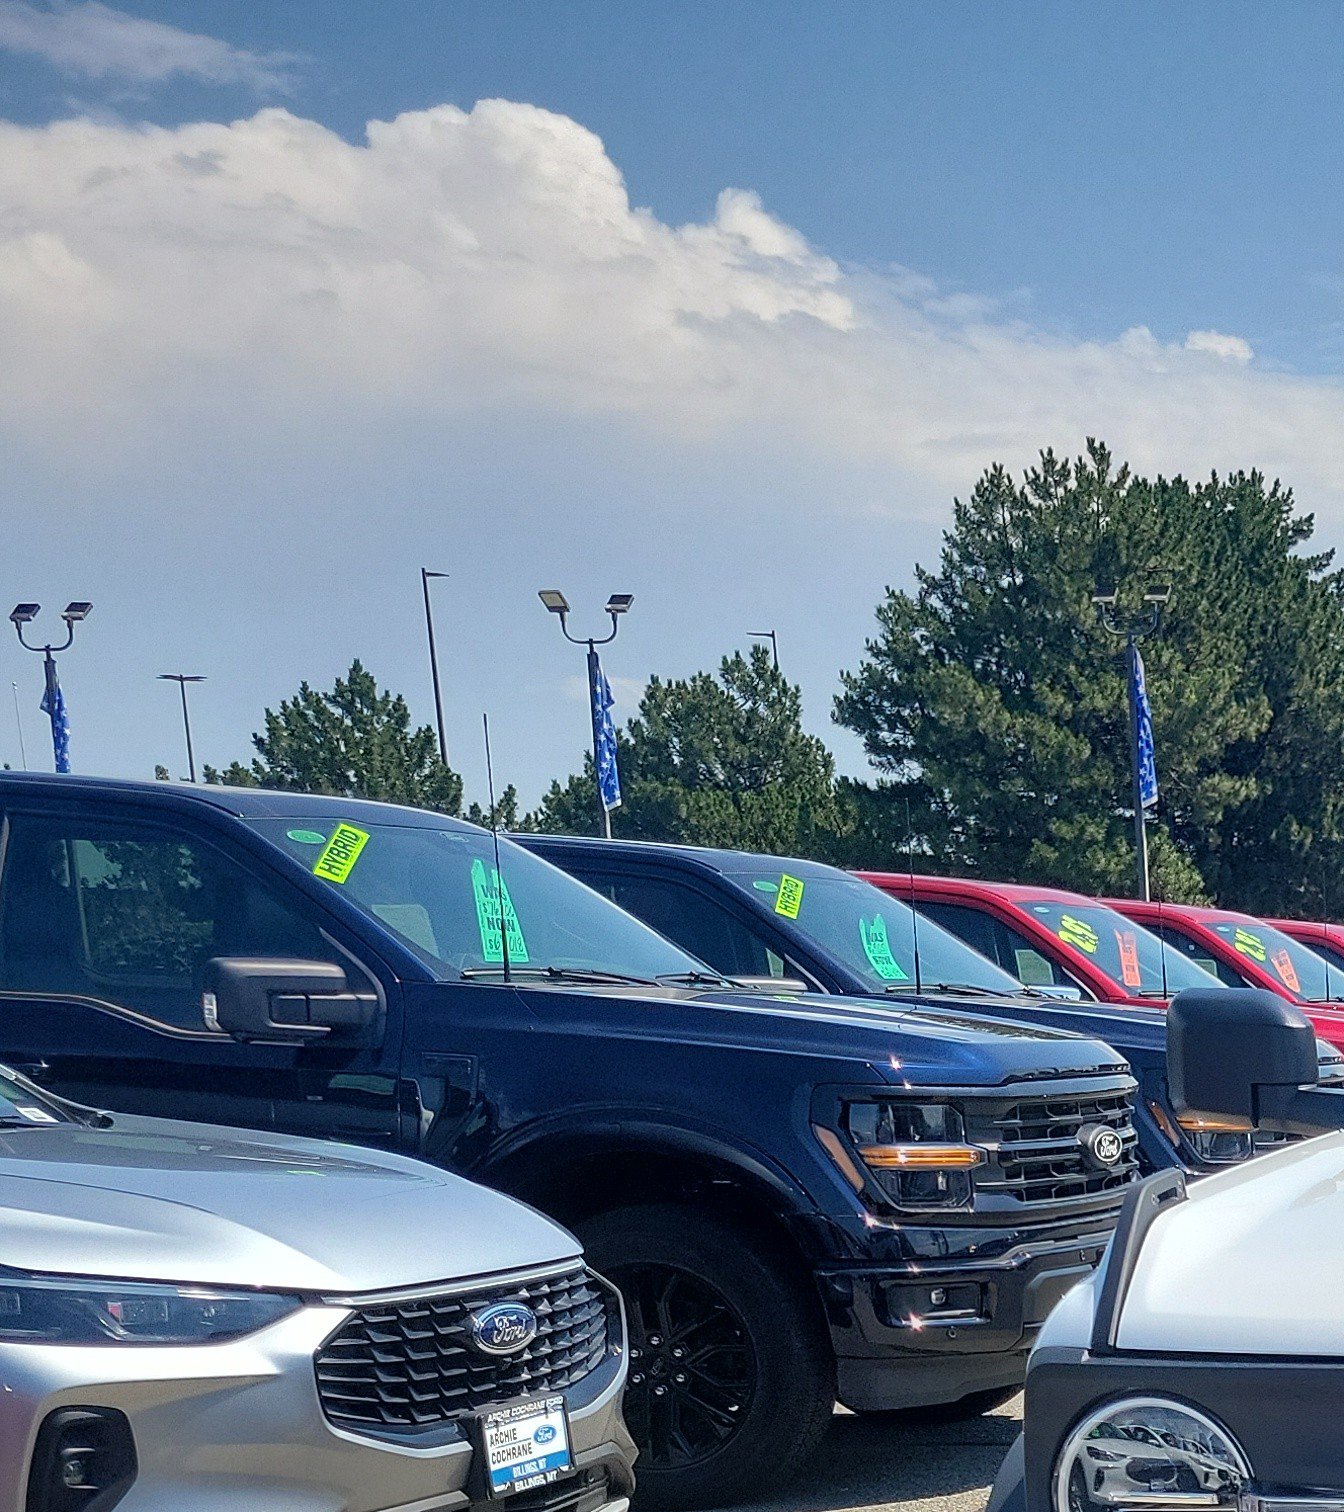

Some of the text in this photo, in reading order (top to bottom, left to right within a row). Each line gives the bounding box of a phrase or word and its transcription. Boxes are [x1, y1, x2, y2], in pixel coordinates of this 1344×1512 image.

[319, 827, 360, 878] HYBRID
[778, 878, 799, 915] HYBRID
[487, 917, 516, 933] NOW
[1100, 1135, 1118, 1157] Ford
[493, 1314, 527, 1344] Ford
[489, 1427, 518, 1448] ARCHIE
[491, 1442, 533, 1465] COCHRANE
